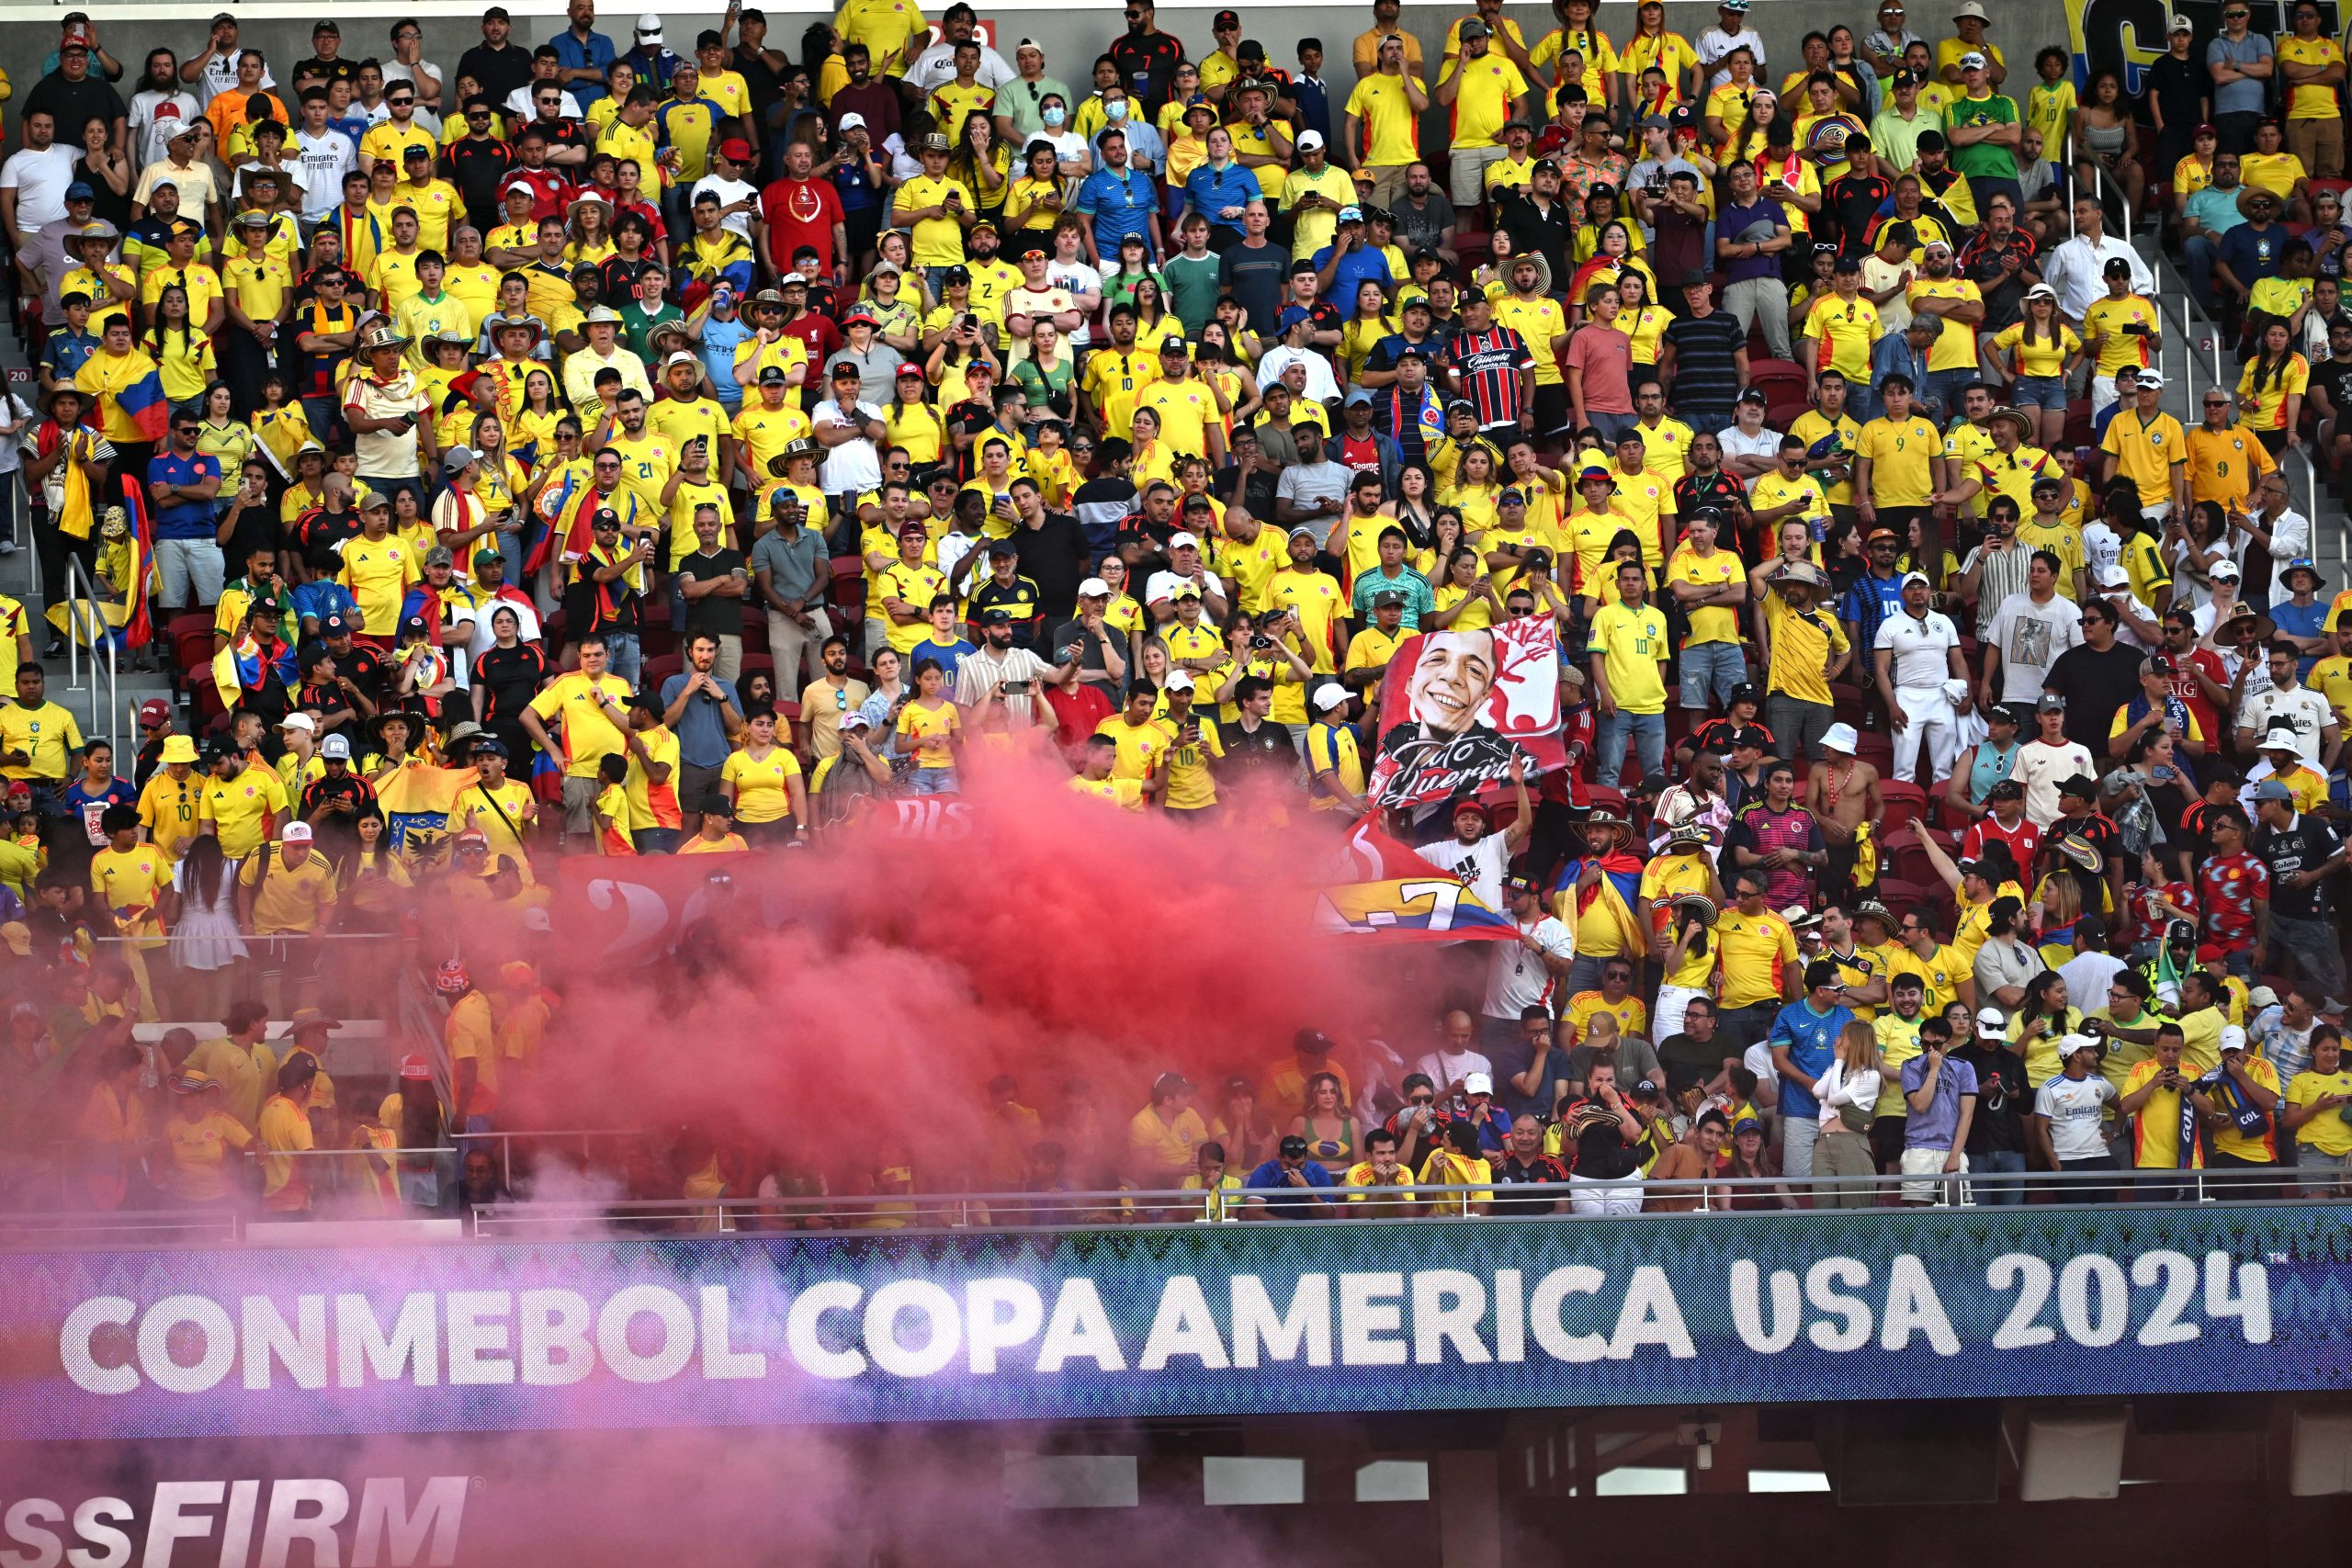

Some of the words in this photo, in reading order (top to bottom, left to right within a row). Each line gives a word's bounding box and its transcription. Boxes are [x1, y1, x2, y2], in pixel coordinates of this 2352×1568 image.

[928, 25, 989, 48] 29
[1142, 55, 1150, 70] 7
[224, 75, 239, 85] BETTE
[2045, 109, 2057, 122] 10
[300, 154, 339, 164] Emirates
[307, 162, 316, 170] FLY
[317, 162, 334, 170] BETTER
[1124, 231, 1142, 240] SMITH
[93, 288, 105, 300] 10
[631, 283, 644, 299] 10
[982, 283, 992, 299] 2
[1466, 354, 1510, 367] Caliente
[1472, 361, 1510, 372] caliente.mx
[838, 363, 853, 373] SF
[11, 371, 28, 382] 20
[1122, 378, 1133, 390] 10
[1896, 437, 1905, 452] 9
[638, 462, 653, 479] 21
[1016, 457, 1028, 472] 2
[1351, 462, 1375, 470] Team
[2217, 461, 2228, 478] 9
[489, 482, 497, 499] 7
[1044, 478, 1049, 490] 7
[1388, 591, 1396, 599] LA
[1883, 600, 1901, 616] 10
[1635, 638, 1647, 655] 10
[2168, 682, 2195, 696] AIG
[2171, 705, 2184, 728] COPA
[29, 739, 40, 756] 7
[1179, 748, 1193, 766] 10
[175, 804, 192, 822] 10
[1925, 988, 1935, 1006] 0
[1592, 1024, 1600, 1035] LA
[2239, 1111, 2260, 1125] COL
[60, 1284, 767, 1395] CONMEBOL
[786, 1278, 1126, 1379] COPA
[1138, 1266, 1697, 1371] AMERICA
[1730, 1254, 1961, 1356] USA
[1986, 1249, 2272, 1351] 2024
